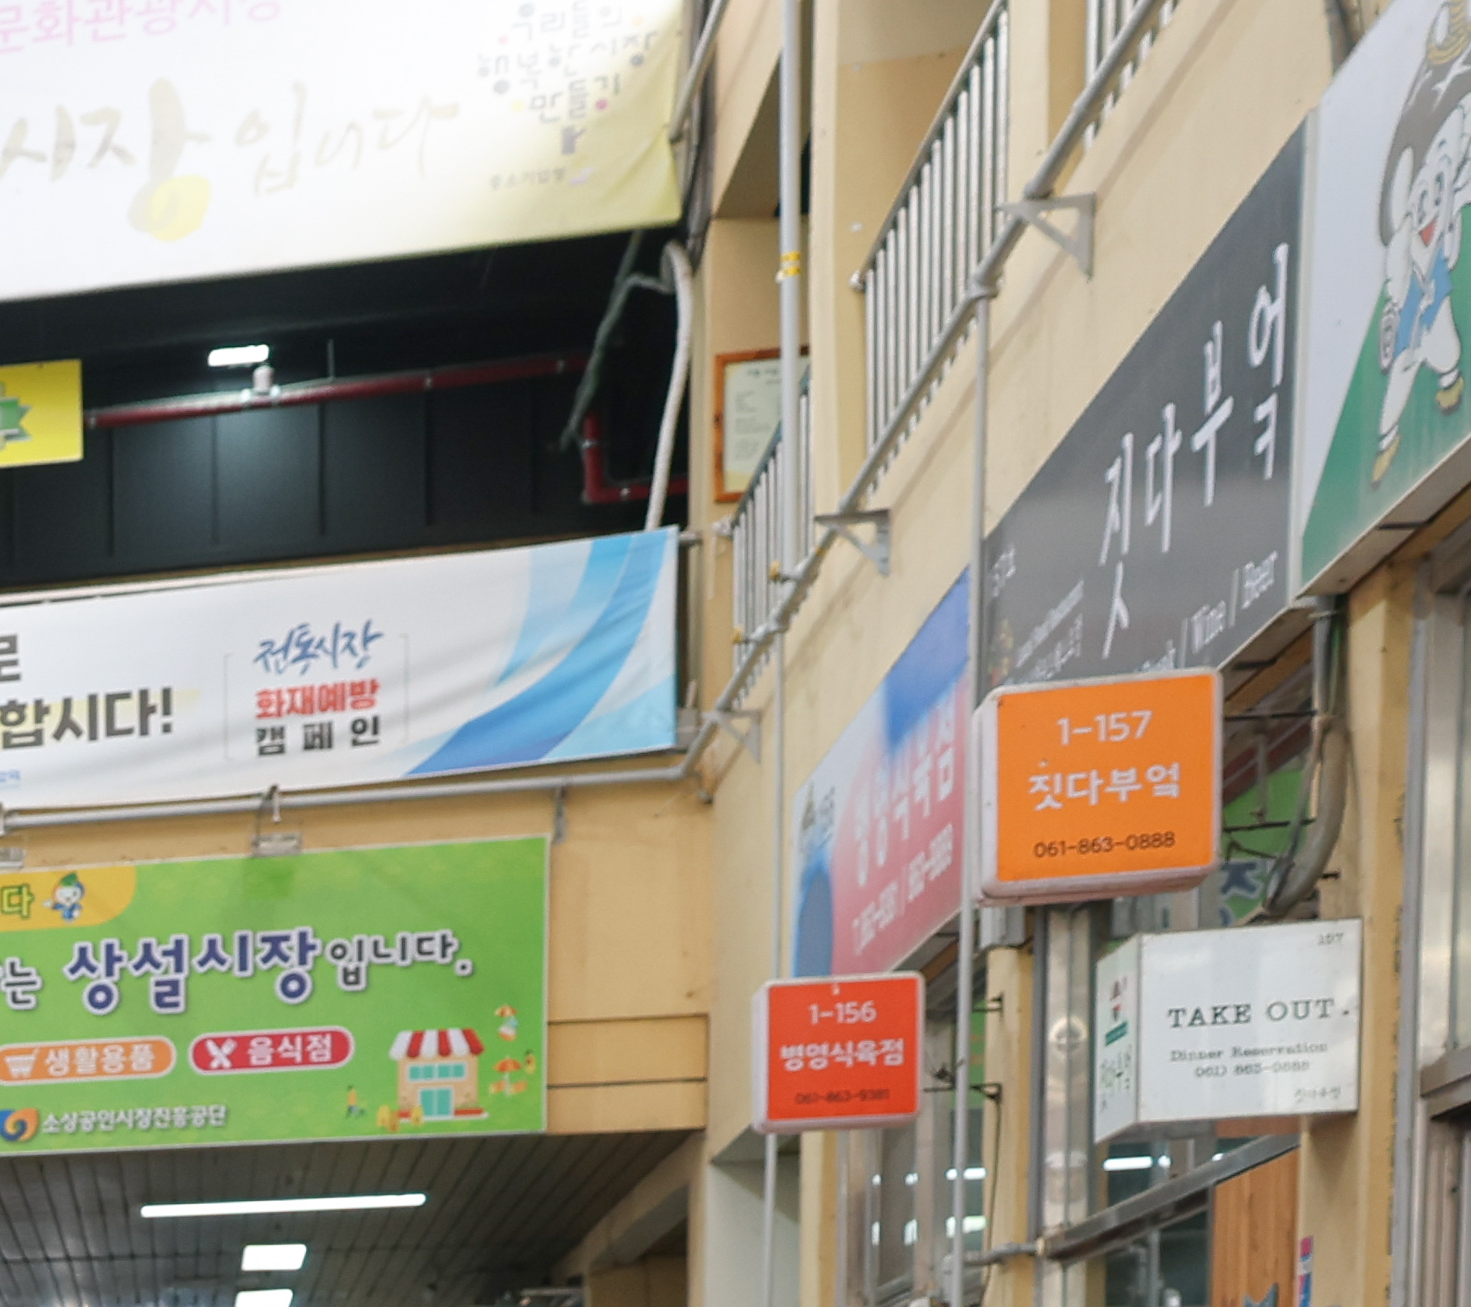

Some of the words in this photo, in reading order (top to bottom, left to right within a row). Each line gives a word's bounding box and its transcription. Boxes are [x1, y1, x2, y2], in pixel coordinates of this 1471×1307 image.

[235, 80, 460, 196] 입니다
[255, 679, 381, 721] 화재예방
[1055, 709, 1153, 746] 1-157
[1028, 761, 1181, 811] 짓다부엌
[1033, 831, 1176, 858] 061-863-0888
[1317, 933, 1344, 945] 157
[808, 1000, 878, 1025] 1-156
[1168, 1004, 1252, 1029] TAKE
[43, 1040, 156, 1077] 생활용품
[246, 1032, 333, 1069] 음식점
[780, 1038, 905, 1071] 병영식육점
[1170, 1047, 1224, 1062] Dinner
[1230, 1041, 1329, 1059] Reservation
